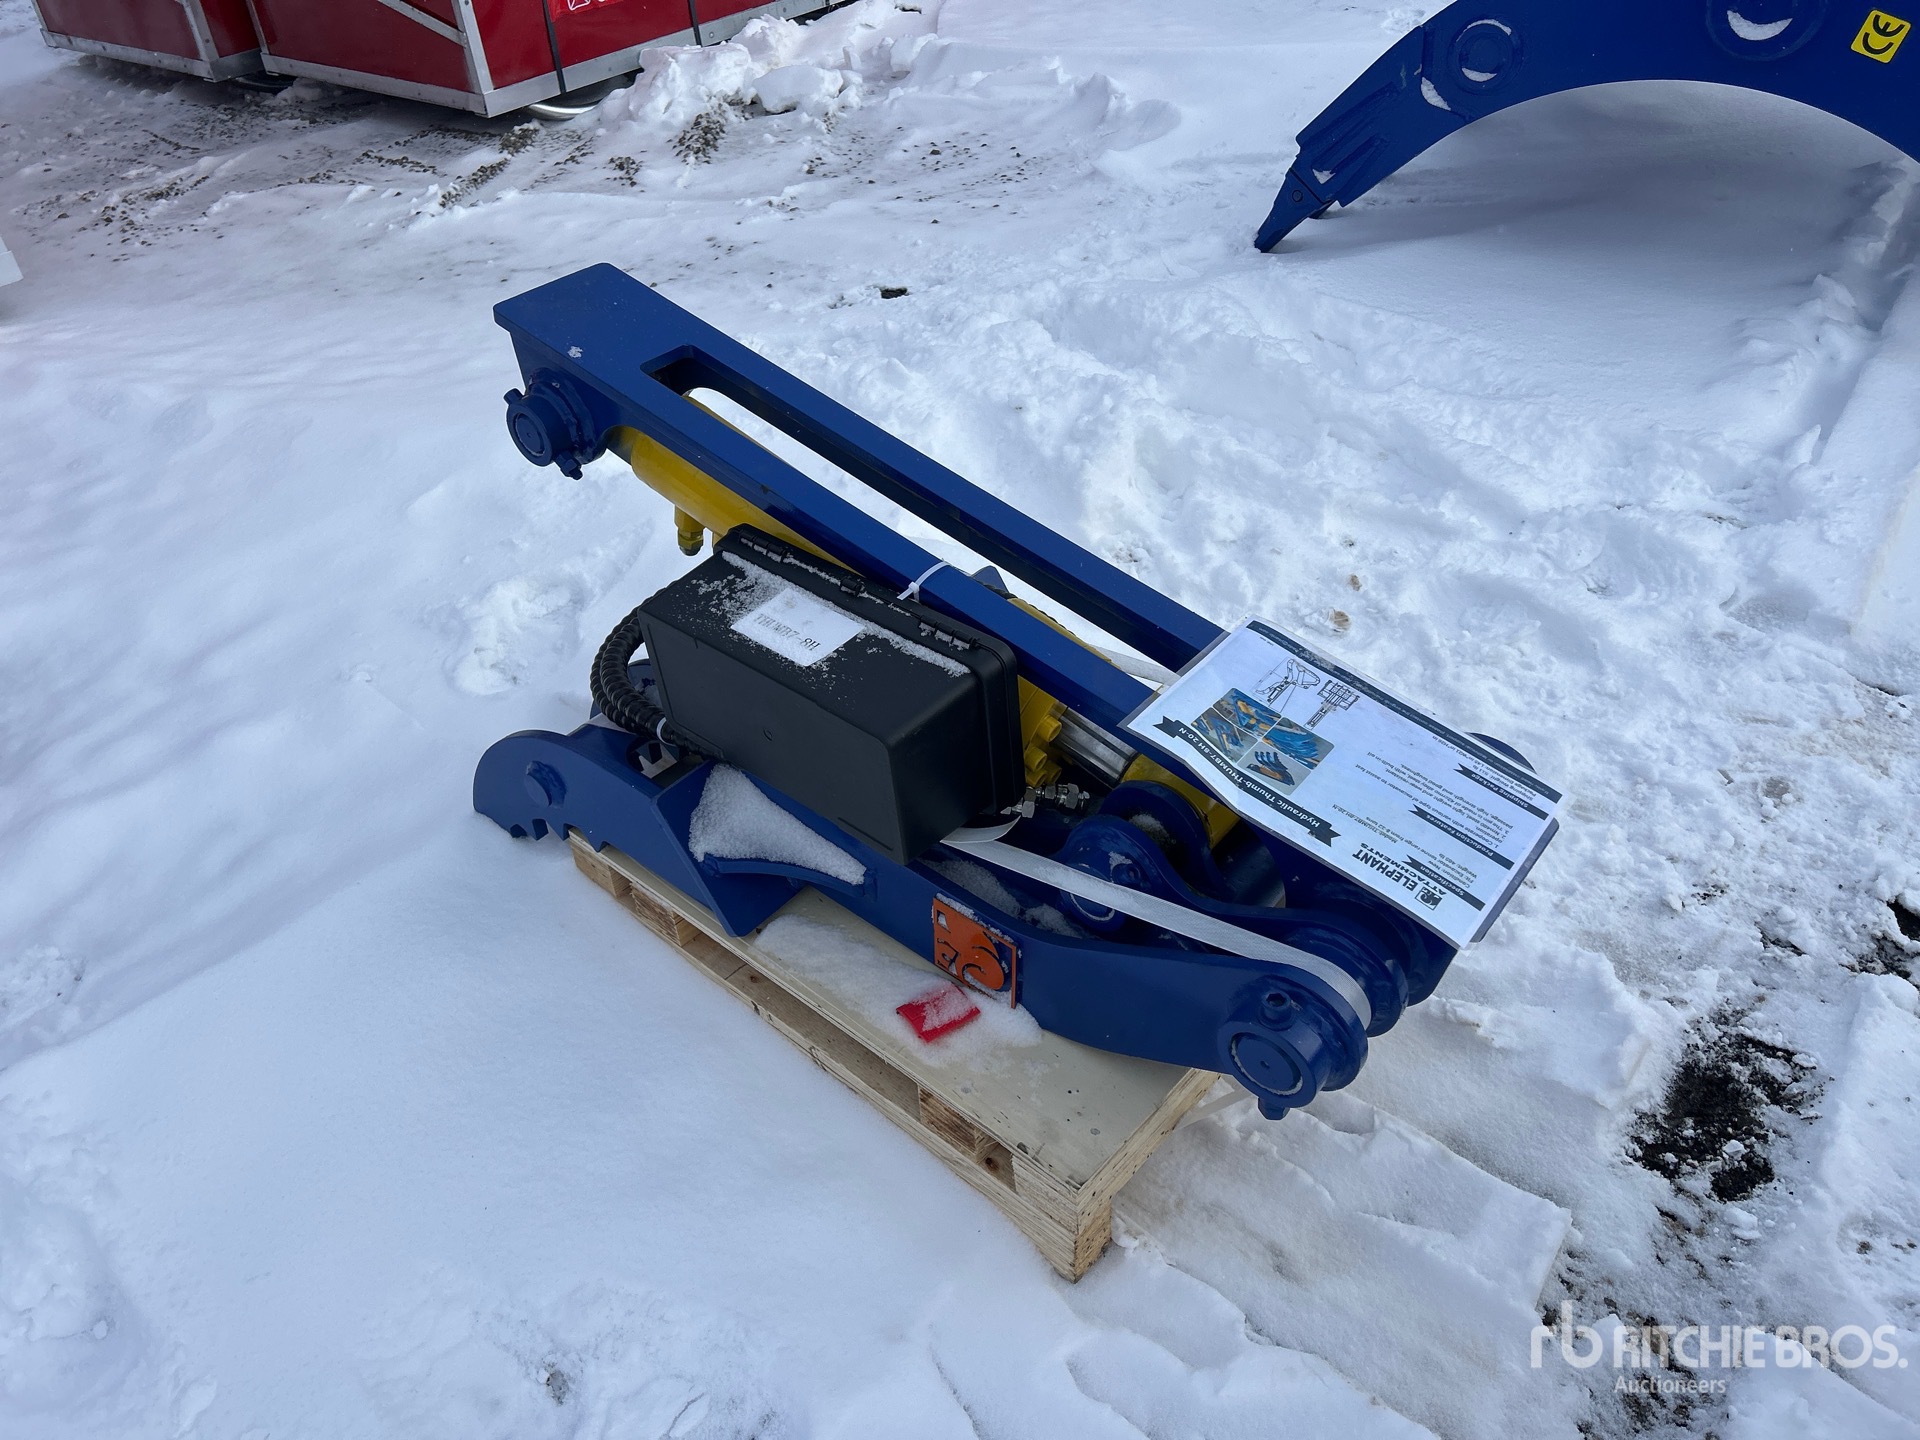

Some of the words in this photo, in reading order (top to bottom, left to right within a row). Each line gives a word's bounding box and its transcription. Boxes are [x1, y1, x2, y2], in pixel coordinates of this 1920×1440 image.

[1178, 727, 1200, 743] 20-N
[1355, 763, 1367, 773] fast
[1374, 755, 1395, 770] built-in
[1197, 742, 1276, 803] Thumb-THUMB7-8H
[1365, 769, 1382, 781] assist
[1394, 766, 1407, 776] with
[1400, 763, 1429, 782] toughness.
[1407, 773, 1422, 784] steel,
[1484, 766, 1515, 785] Dimension:
[1385, 767, 1423, 792] wear-resistant.
[1420, 781, 1435, 792] alloy
[1427, 779, 1444, 790] good
[1471, 773, 1499, 791] Package
[1489, 775, 1510, 788] Weight:
[1387, 782, 1413, 799] excavator
[1421, 789, 1434, 797] and
[1441, 787, 1454, 796] and
[1508, 785, 1534, 802] Shipping
[1513, 782, 1537, 798] Package
[1418, 800, 1432, 810] type
[1432, 795, 1453, 808] weight
[1453, 794, 1477, 809] strength
[1498, 788, 1529, 808] Shipping
[1276, 799, 1321, 828] Hydraulic
[1431, 807, 1452, 821] various
[1451, 806, 1466, 817] light
[1461, 805, 1478, 816] made
[1476, 807, 1490, 817] high
[1365, 816, 1379, 826] tons
[1426, 814, 1456, 834] Features
[1451, 819, 1465, 829] with
[1465, 813, 1481, 824] steel,
[1489, 813, 1514, 830] passage,
[1475, 825, 1503, 844] operation.
[1492, 822, 1503, 832] The
[1378, 829, 1399, 844] Model:
[1390, 830, 1405, 842] from
[1464, 826, 1494, 846] Cooperate
[1404, 839, 1421, 851] range
[1455, 832, 1494, 857] Production
[1420, 848, 1438, 861] tonne
[1352, 848, 1418, 893] ELEPHANT
[1360, 842, 1447, 896] ATTACHMENTS
[1427, 860, 1441, 871] New
[1437, 859, 1465, 878] Excavator
[1457, 863, 1478, 879] Weight:
[1420, 865, 1465, 896] Specification
[1441, 868, 1471, 889] Condition:
